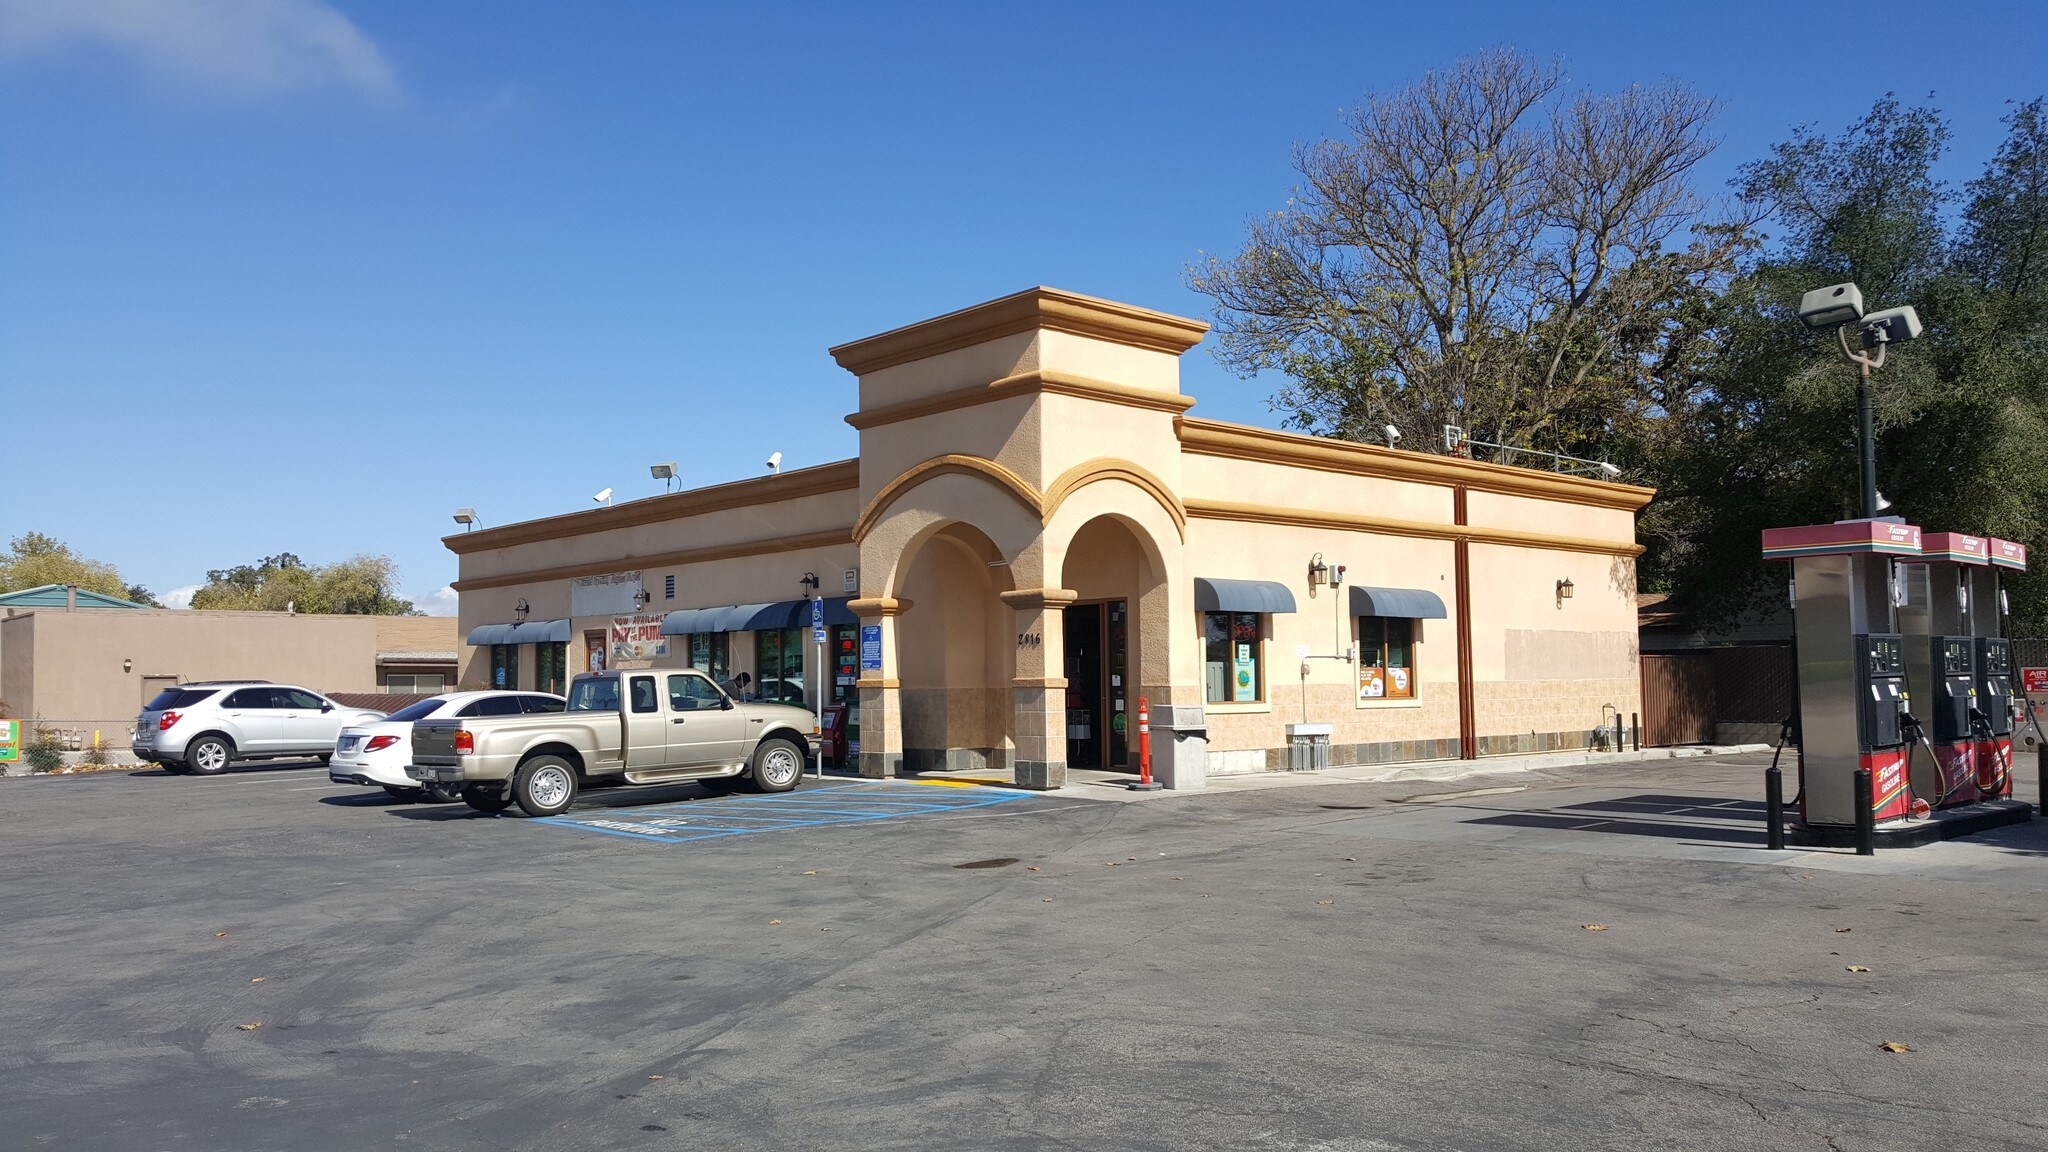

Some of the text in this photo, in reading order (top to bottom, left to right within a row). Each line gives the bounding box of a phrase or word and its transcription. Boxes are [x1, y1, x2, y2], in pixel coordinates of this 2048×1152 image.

[1913, 530, 1919, 550] 6
[1981, 542, 1987, 560] 4
[612, 628, 631, 642] PAY
[638, 625, 666, 641] PUM
[1018, 633, 1041, 645] 2816
[1881, 773, 1901, 794] GASOLINE
